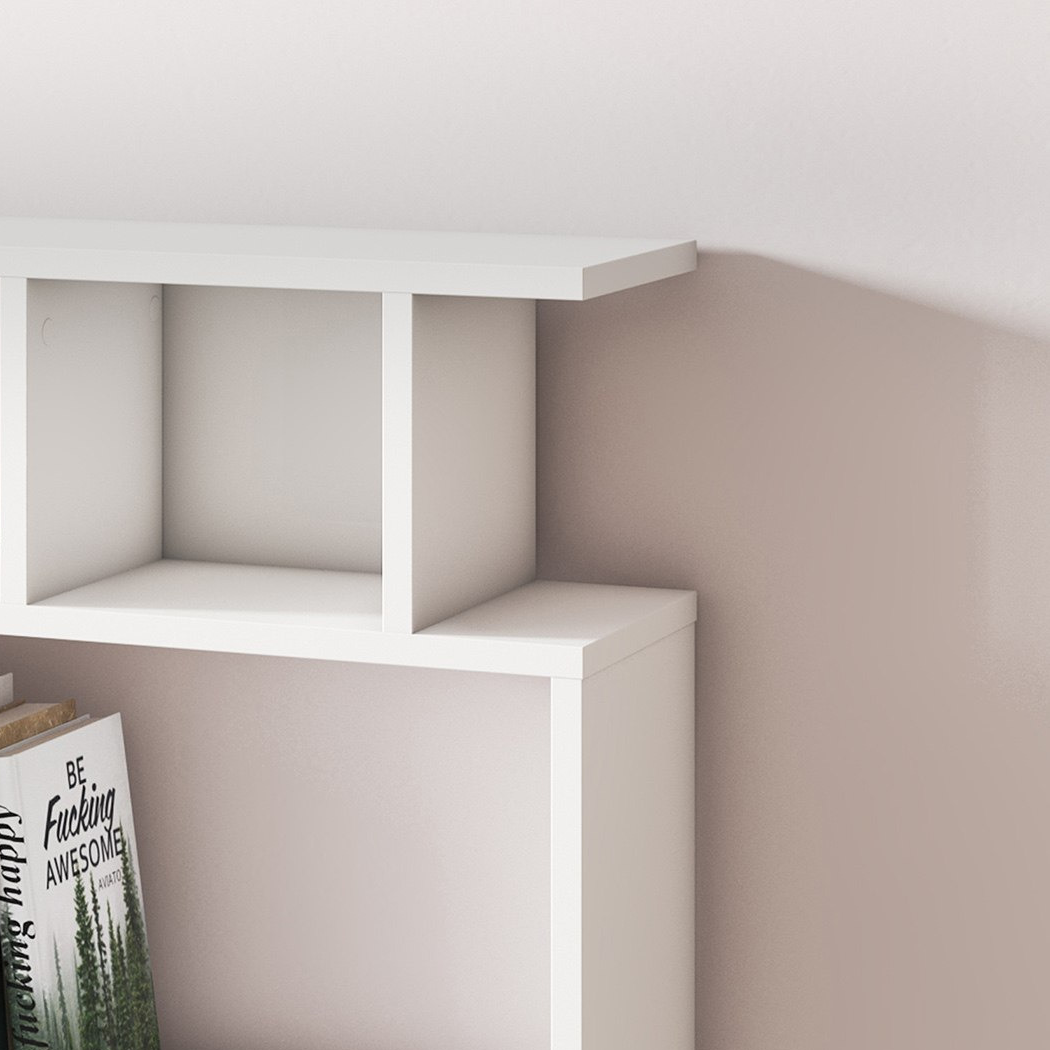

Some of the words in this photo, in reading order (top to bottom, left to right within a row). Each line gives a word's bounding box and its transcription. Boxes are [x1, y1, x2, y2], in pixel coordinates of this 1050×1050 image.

[66, 755, 87, 789] BE
[43, 783, 115, 850] Fucking
[46, 827, 123, 890] AWESOME
